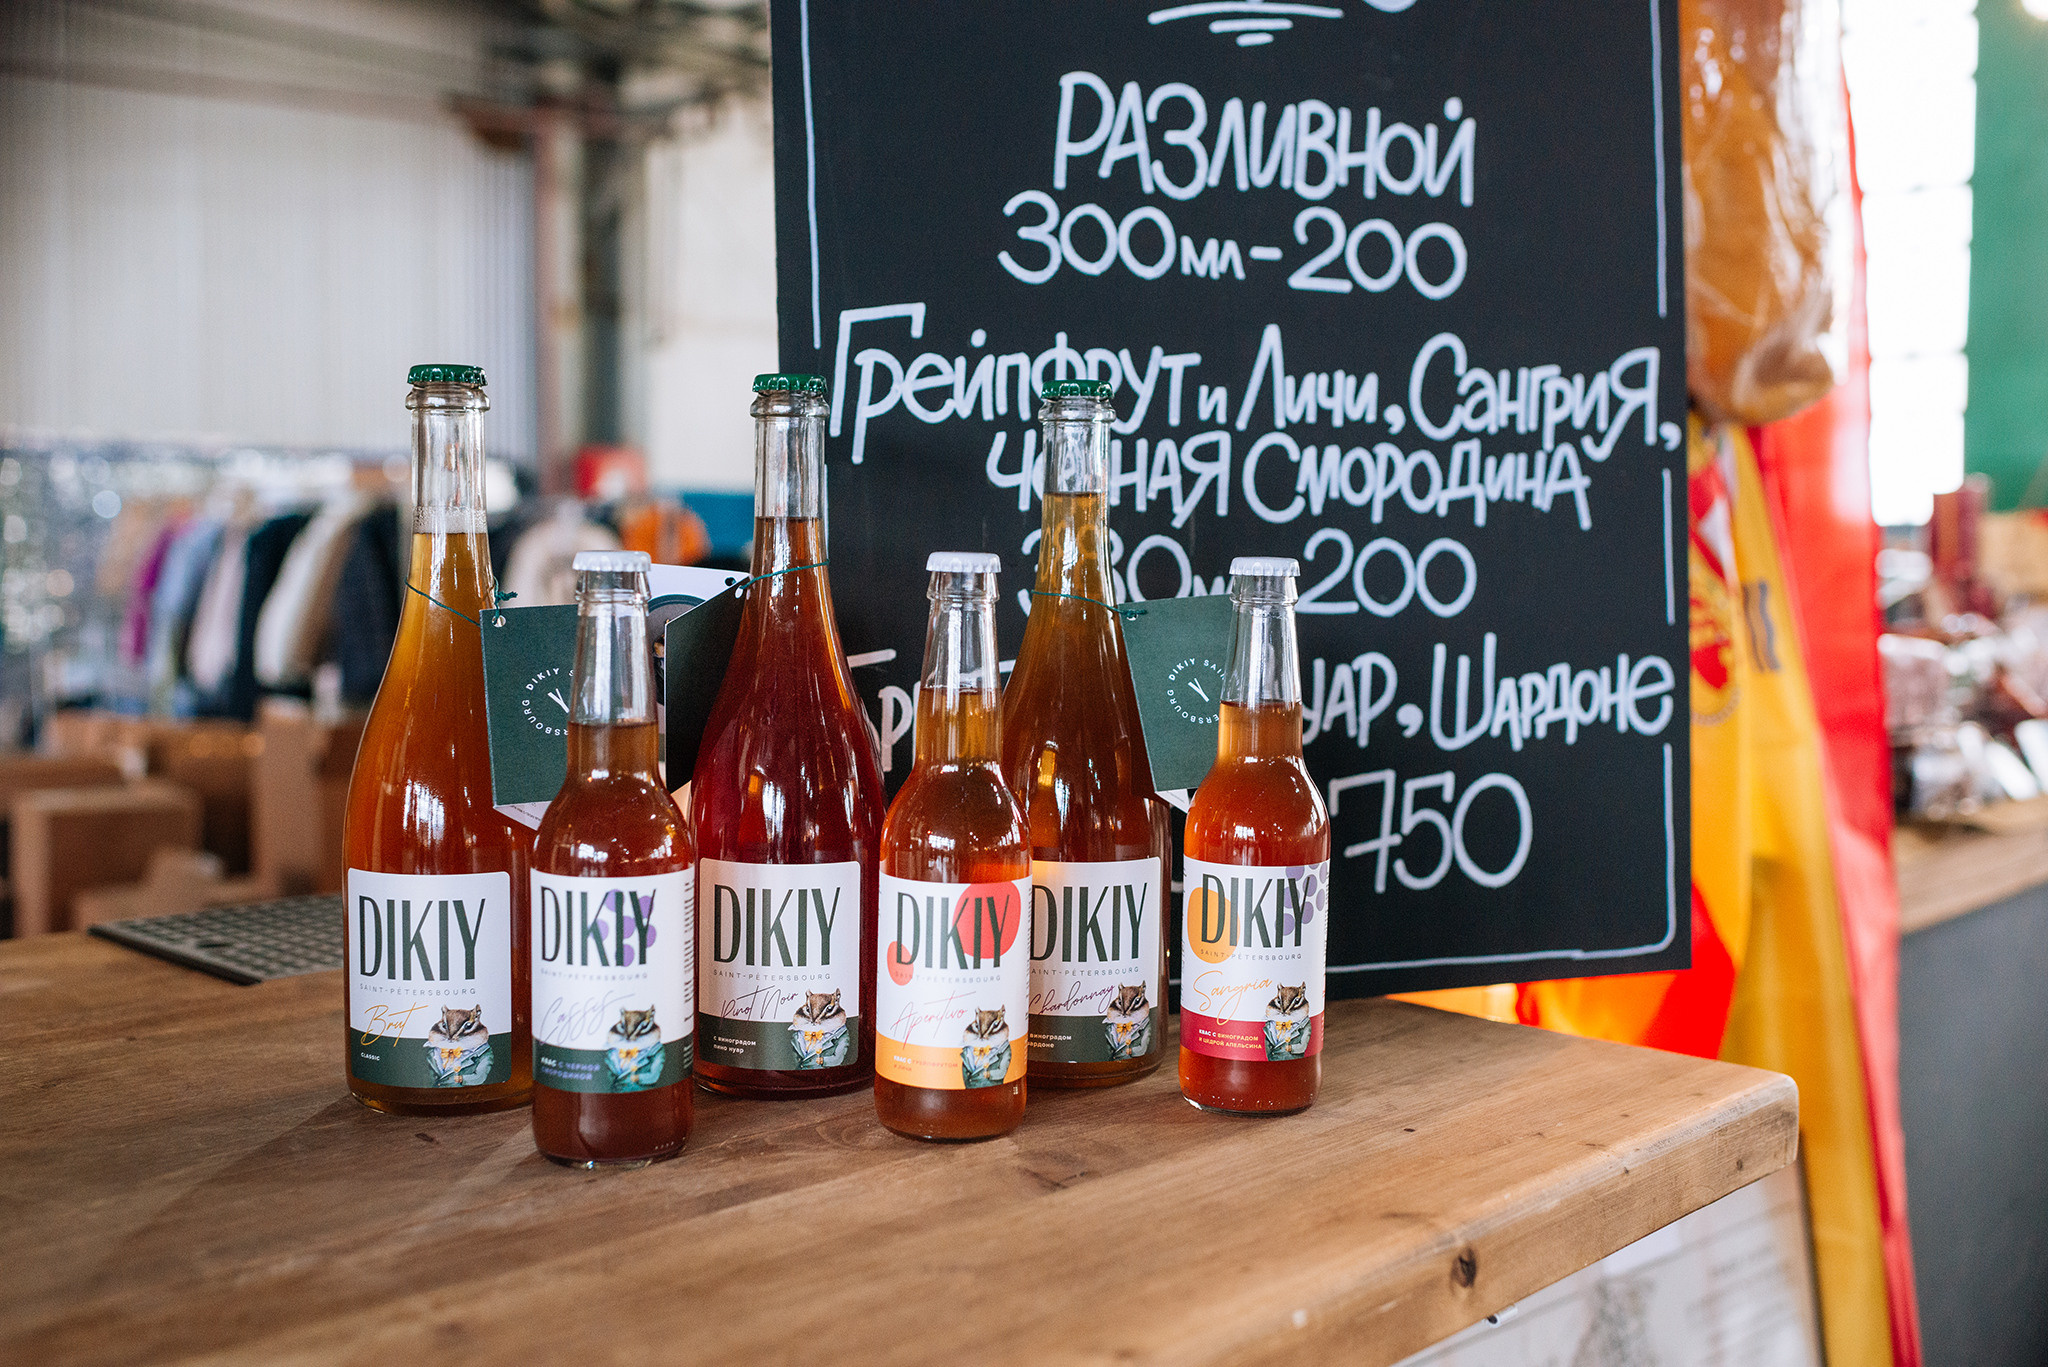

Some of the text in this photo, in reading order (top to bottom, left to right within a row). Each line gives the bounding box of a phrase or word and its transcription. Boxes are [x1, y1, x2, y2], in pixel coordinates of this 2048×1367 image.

[1053, 70, 1477, 207] РАЗЛИВНОЙ
[525, 667, 560, 691] DIKIY
[1168, 658, 1195, 681] DIKIY
[1329, 768, 1533, 894] 750
[358, 894, 486, 981] DIKIY
[540, 886, 656, 967] DIKIY
[713, 884, 841, 967] DIKIY
[896, 892, 1010, 970] DIKIY
[1029, 882, 1147, 963] DIKIY
[1201, 873, 1311, 948] DIKIY
[718, 985, 798, 1027] Pinot Noir
[1029, 980, 1116, 1016] Chardonnay
[1031, 966, 1139, 977] AINT-PÉTERSBOURG
[1193, 970, 1273, 1026] Sangria
[360, 1001, 429, 1048] Brut
